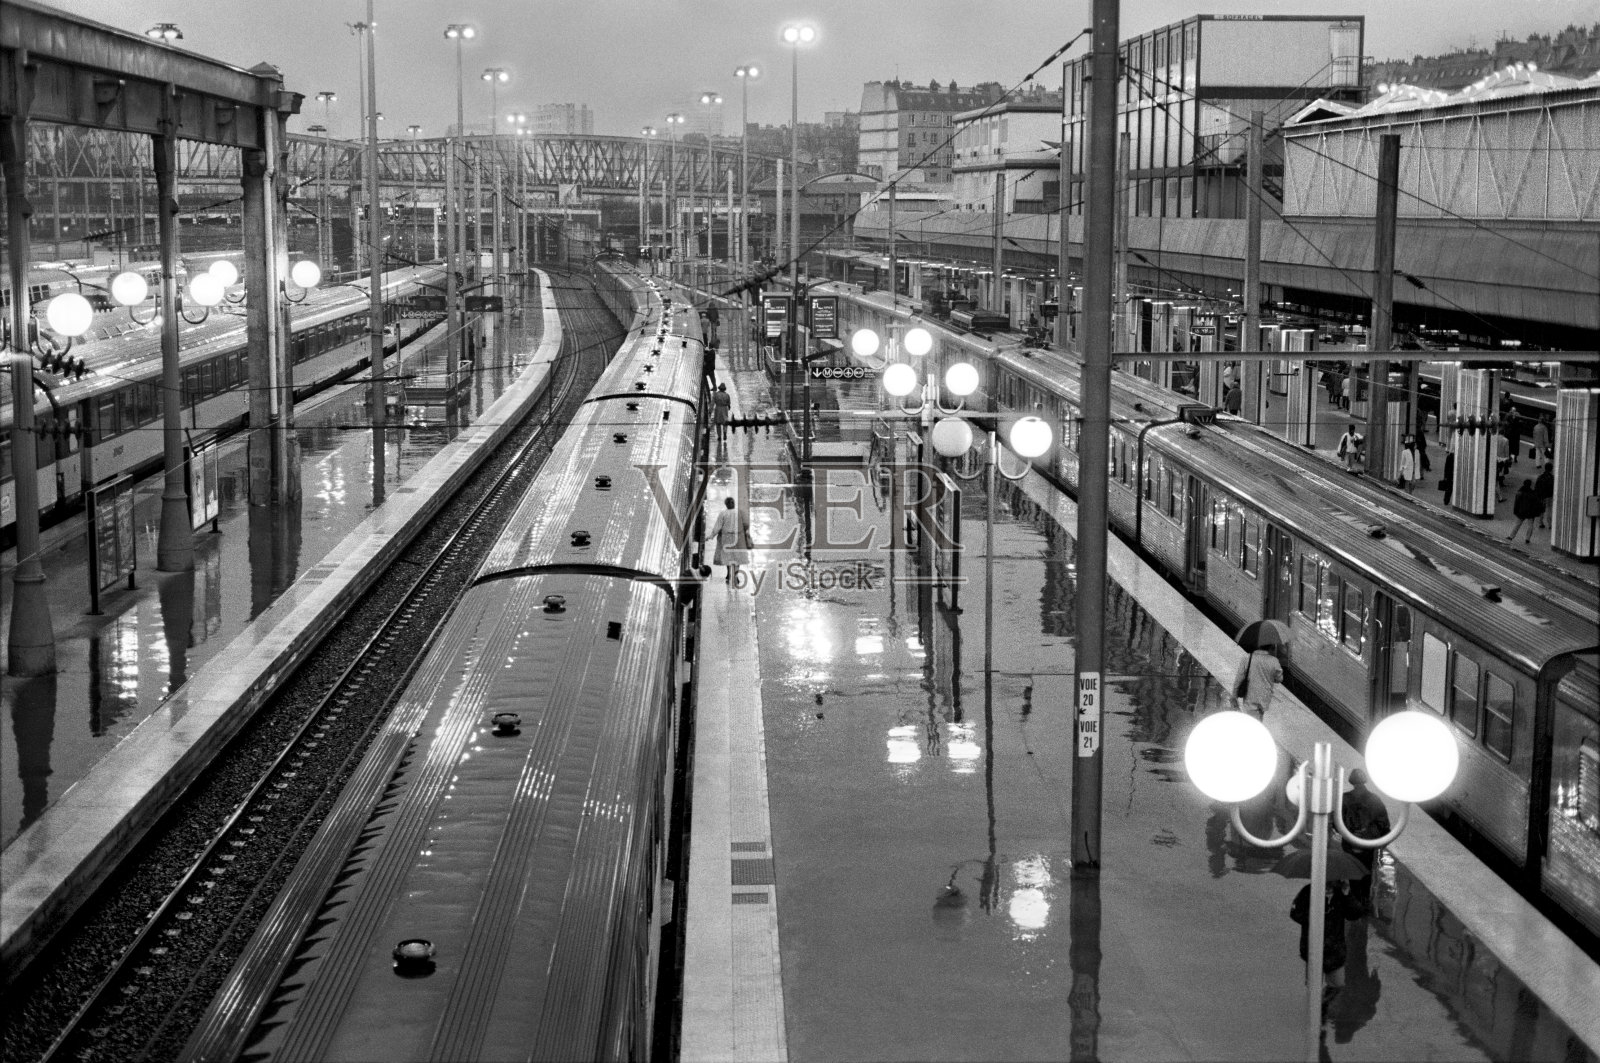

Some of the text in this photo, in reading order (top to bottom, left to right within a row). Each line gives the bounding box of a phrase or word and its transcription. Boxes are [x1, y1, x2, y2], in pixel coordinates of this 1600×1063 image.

[1080, 679, 1097, 690] VOIE
[1083, 693, 1094, 706] 20
[1080, 721, 1097, 732] VOIE
[1083, 737, 1093, 748] 21
